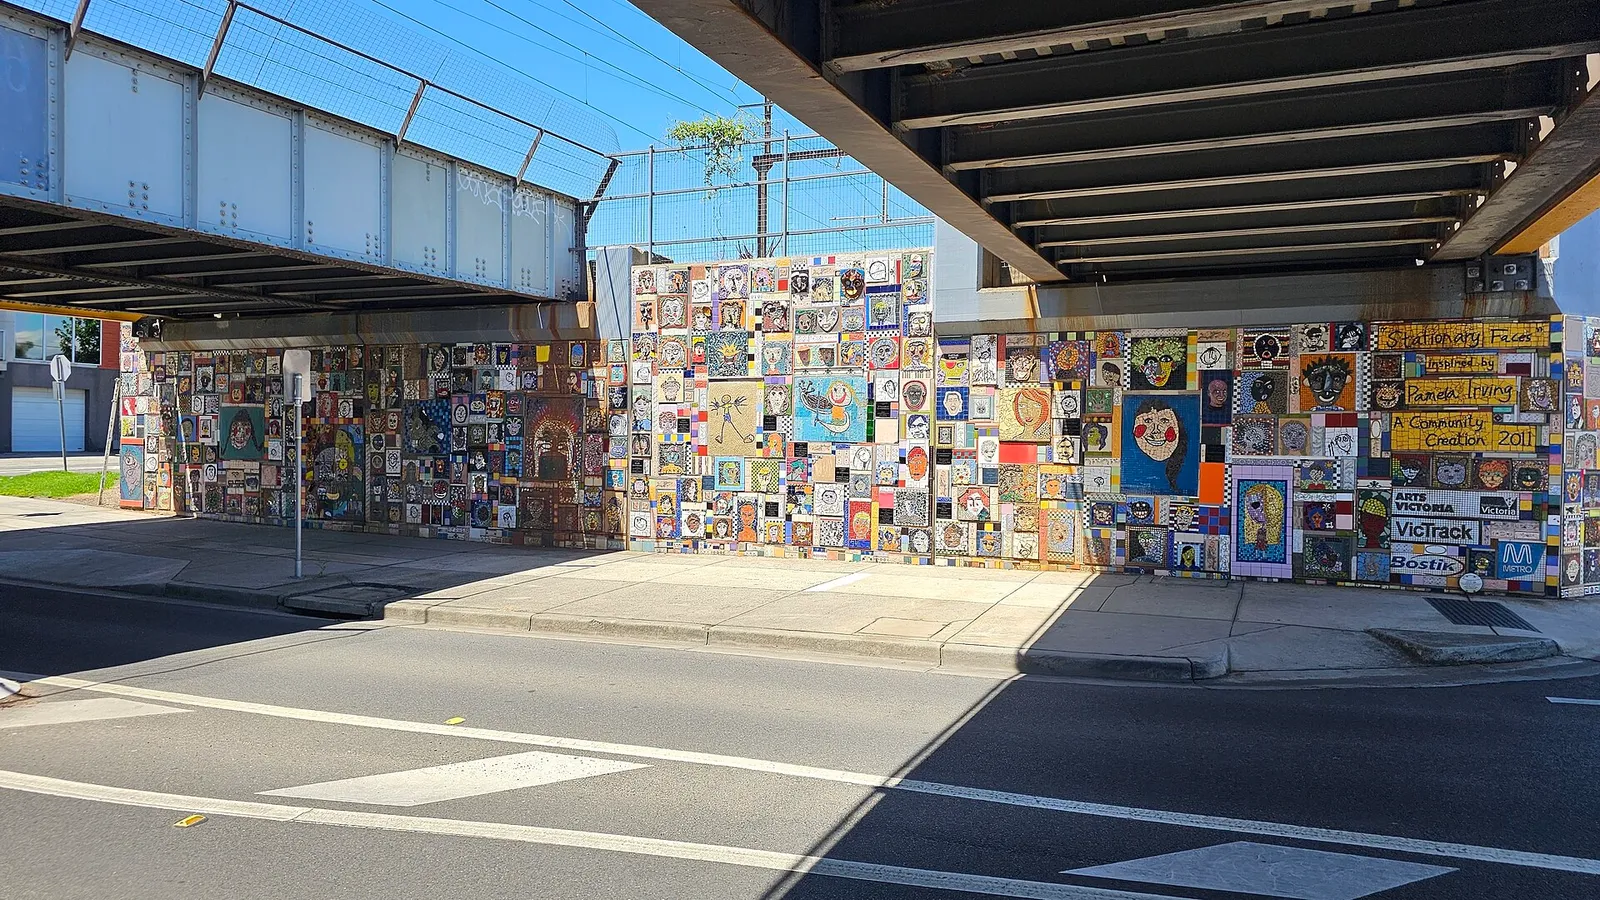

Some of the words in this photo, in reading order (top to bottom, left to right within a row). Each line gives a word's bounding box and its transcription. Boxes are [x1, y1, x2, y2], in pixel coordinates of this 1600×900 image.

[1481, 357, 1494, 370] by
[1408, 385, 1459, 402] Pamela
[1467, 381, 1512, 402] Irving
[1393, 416, 1404, 429] A
[1409, 414, 1484, 431] Community
[1425, 431, 1486, 447] Creation
[1498, 431, 1531, 447] 2011
[1395, 492, 1427, 501] ARTS
[1395, 502, 1454, 514] VICTORIA
[1481, 506, 1516, 516] Victoria
[1395, 521, 1473, 540] VicTrack
[1391, 555, 1457, 572] Bostik
[1502, 564, 1533, 574] METRO
